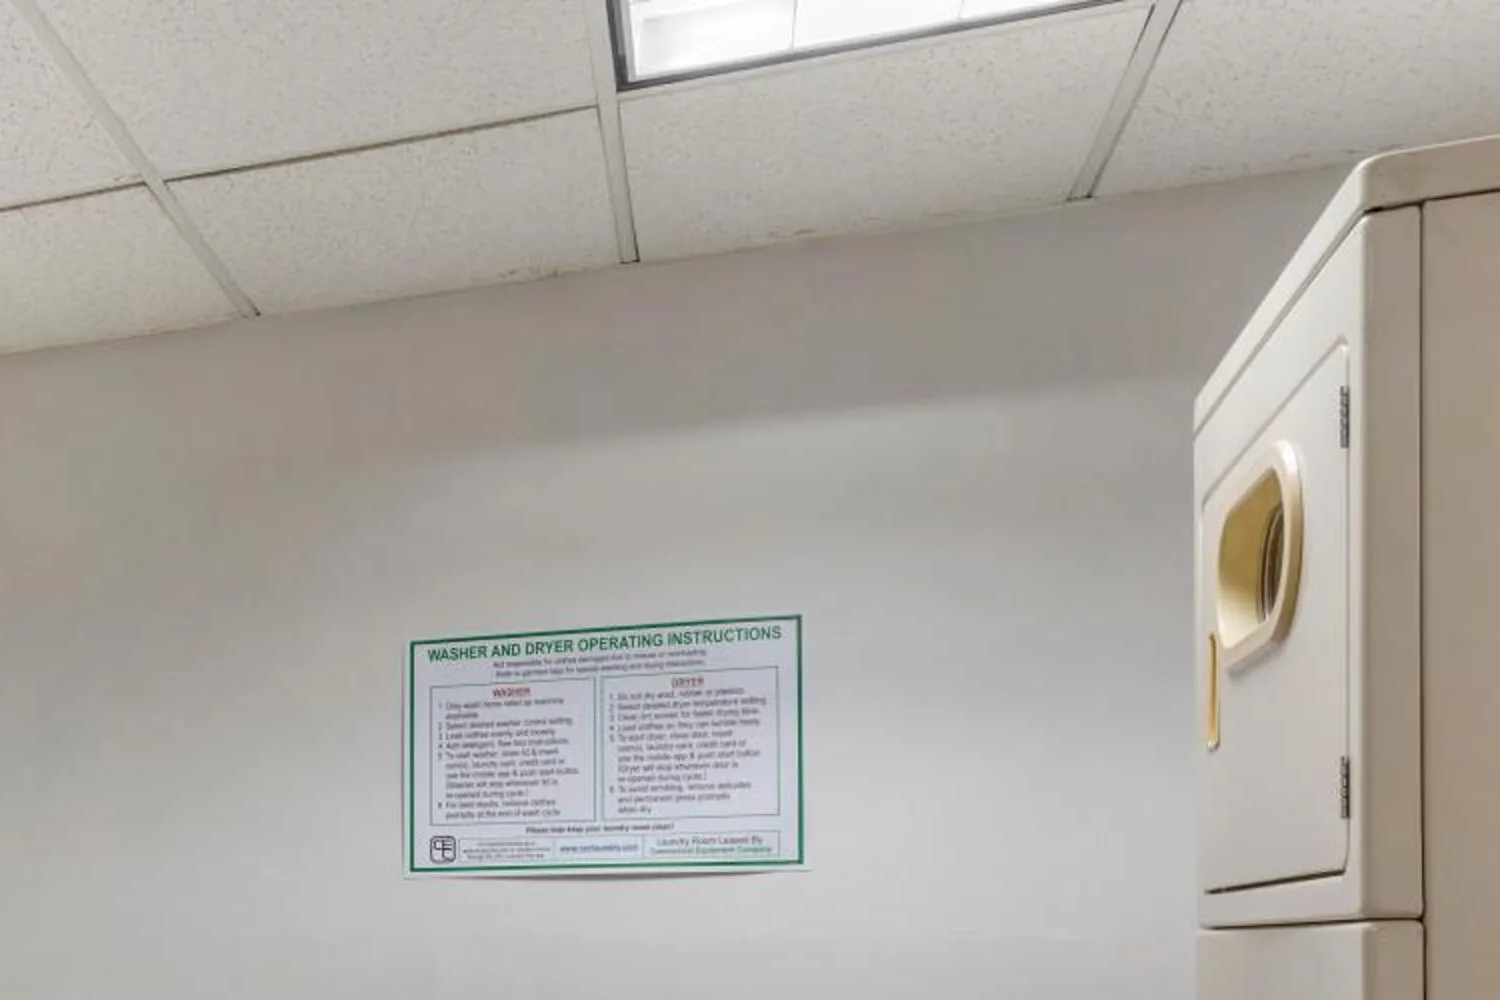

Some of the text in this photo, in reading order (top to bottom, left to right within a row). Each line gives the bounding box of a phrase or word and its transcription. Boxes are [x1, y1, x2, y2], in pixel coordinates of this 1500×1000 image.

[427, 645, 487, 662] WASHER
[491, 643, 521, 659] AND
[525, 639, 573, 656] DRYER
[577, 633, 664, 652] OPERATING
[668, 625, 782, 646] INSTRUCTIONS
